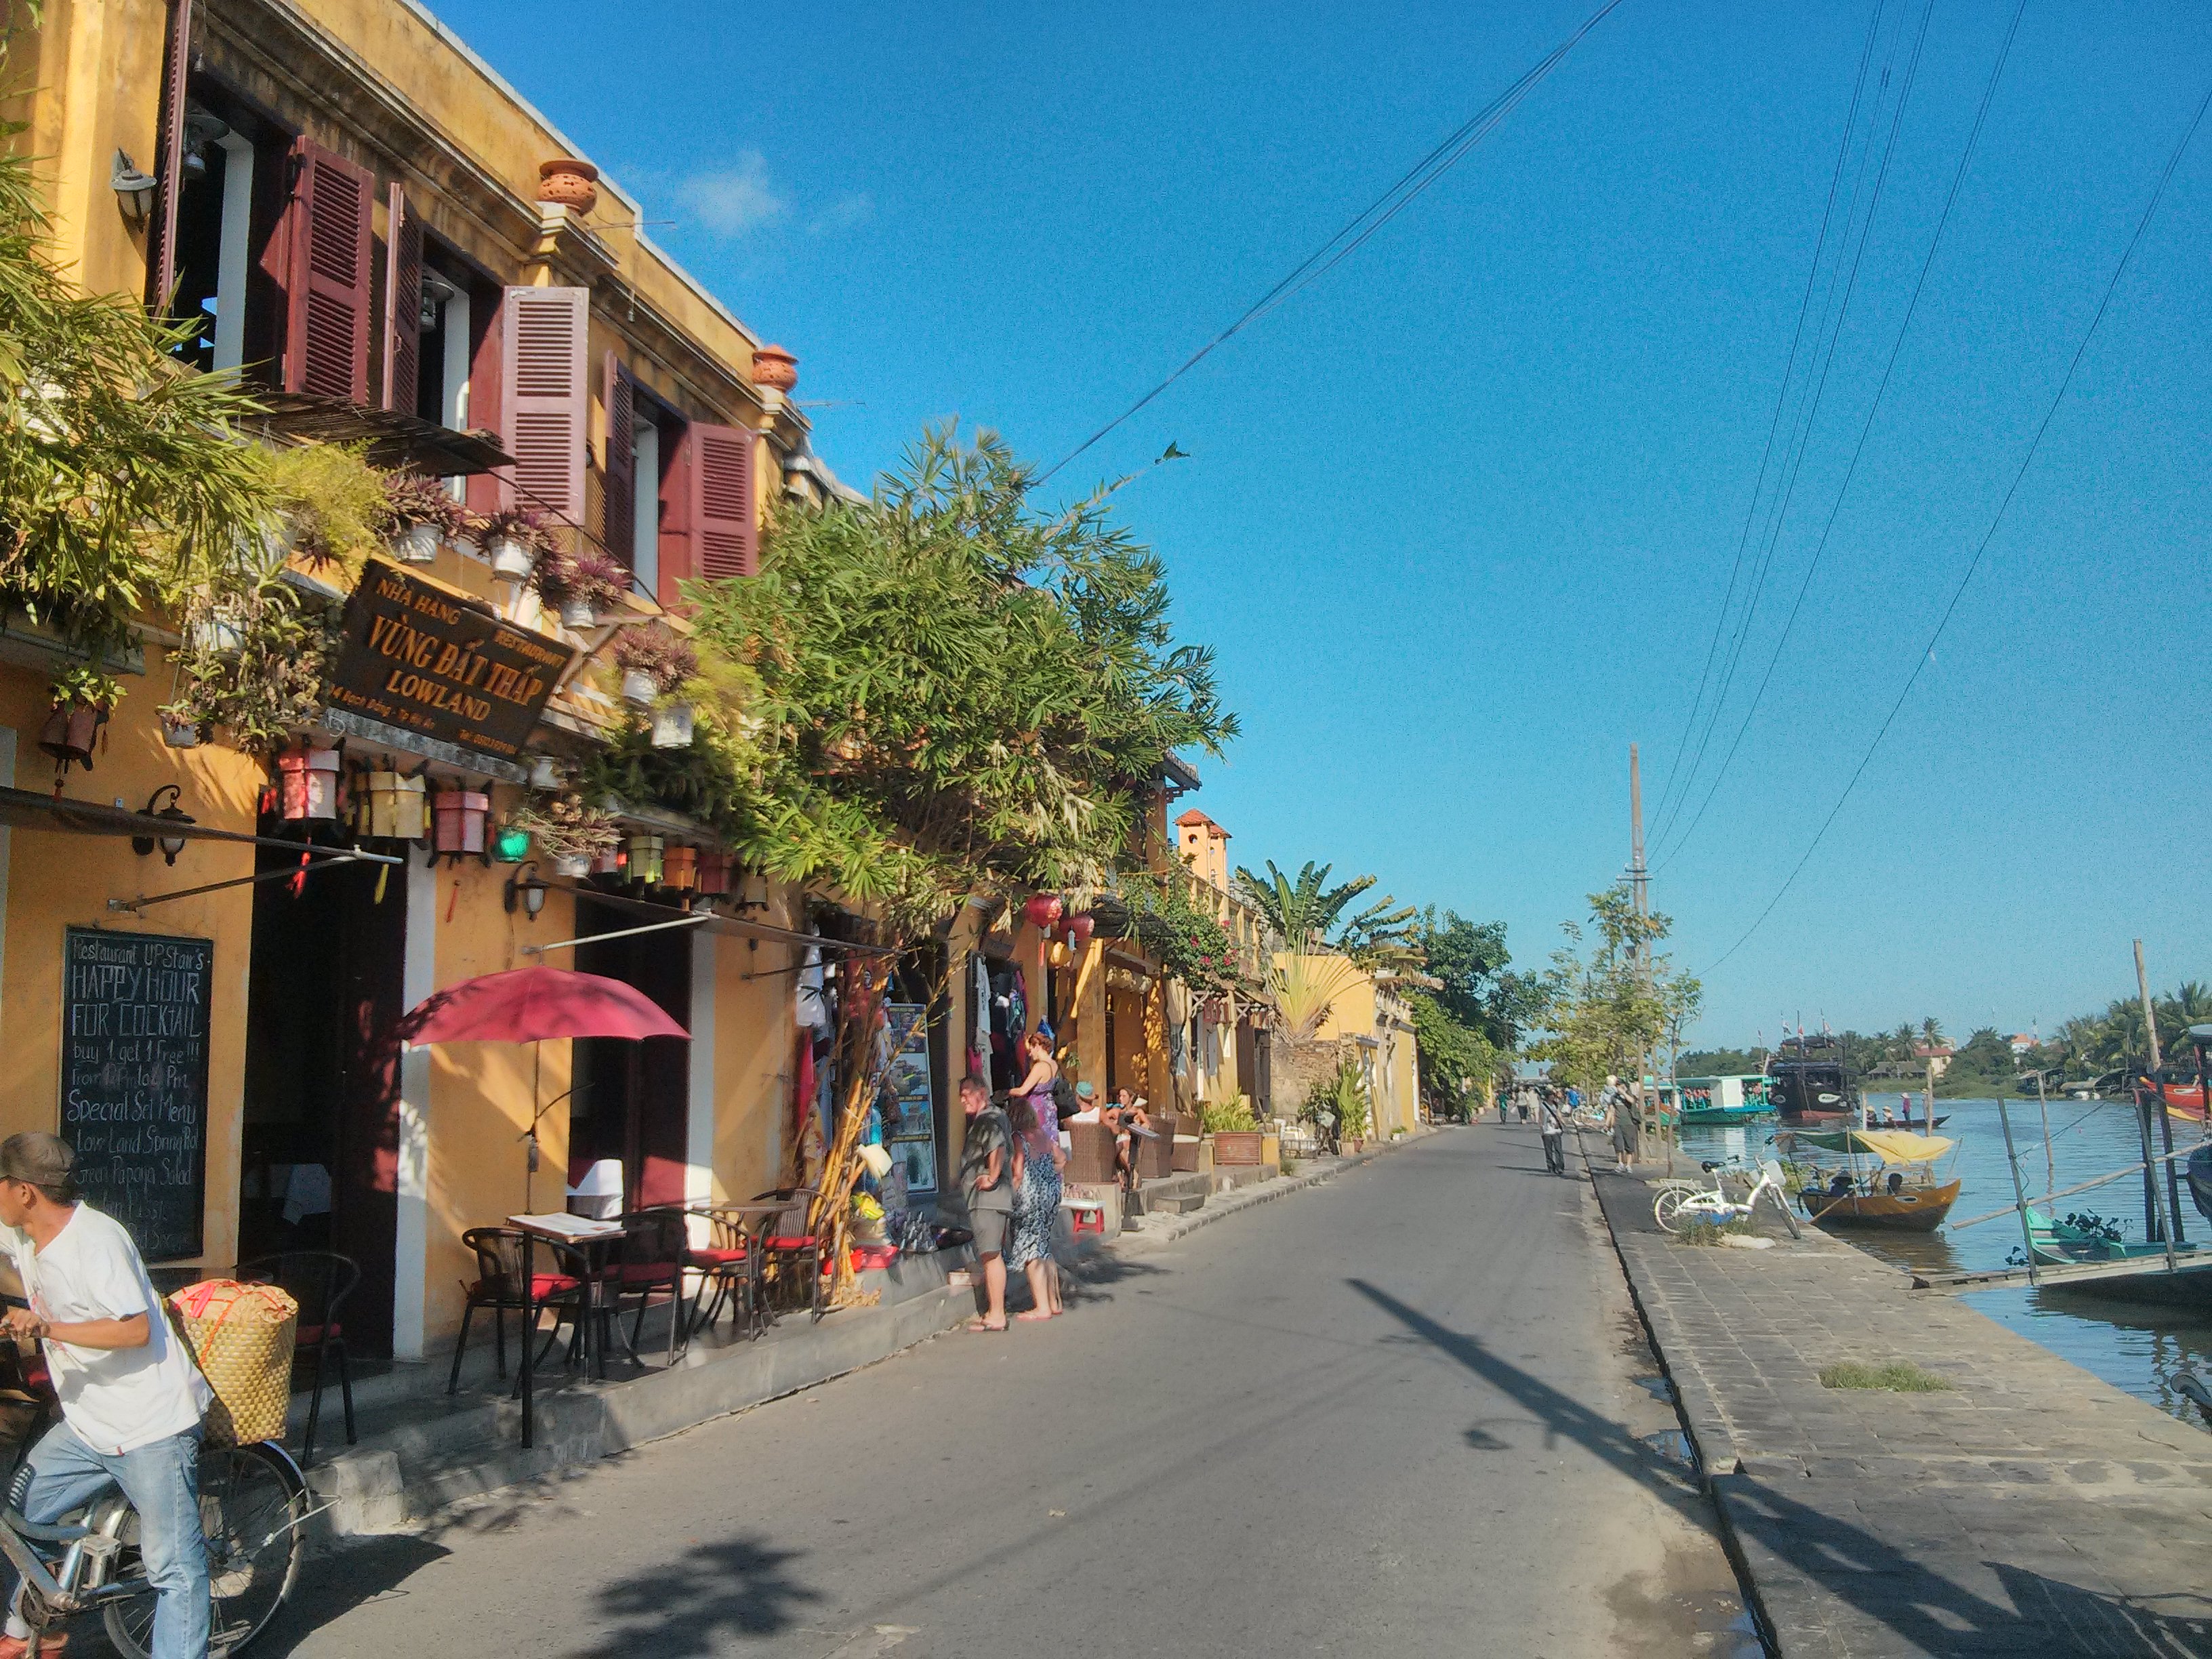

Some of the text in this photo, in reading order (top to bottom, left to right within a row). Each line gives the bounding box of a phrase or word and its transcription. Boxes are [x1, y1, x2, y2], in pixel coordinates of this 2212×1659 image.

[368, 613, 438, 669] VÙNG
[386, 669, 491, 721] LOWLAND
[72, 937, 137, 965] Restaurant
[73, 964, 199, 1004] HAPPY HOUR
[72, 1003, 202, 1038] FOR COCKTAIL
[73, 1041, 99, 1066] buy
[119, 1040, 140, 1065] get
[67, 1088, 197, 1125] Special Set Menu
[77, 1128, 105, 1153] Low
[108, 1125, 142, 1154] Land
[111, 1155, 155, 1195] Papaya
[159, 1153, 192, 1186] Salad
